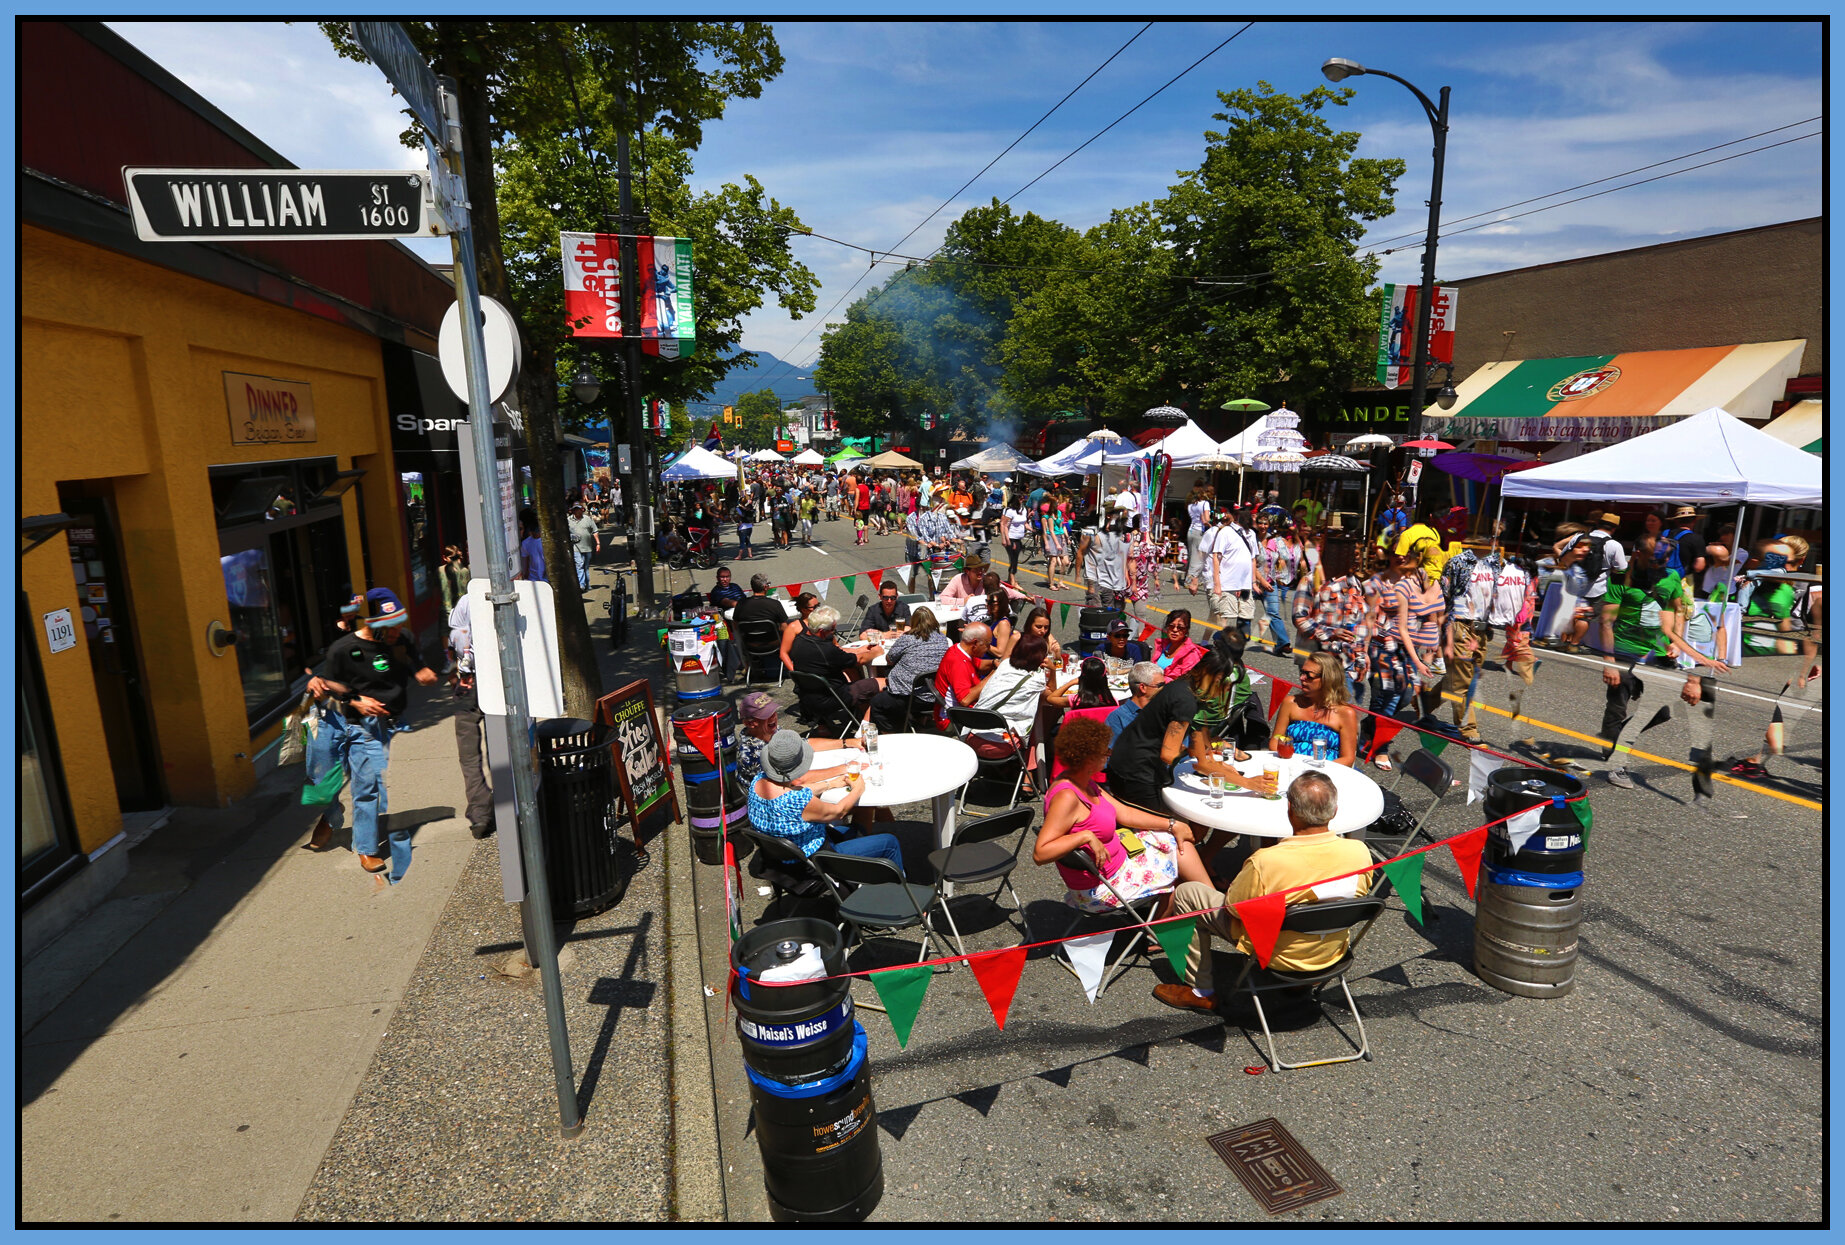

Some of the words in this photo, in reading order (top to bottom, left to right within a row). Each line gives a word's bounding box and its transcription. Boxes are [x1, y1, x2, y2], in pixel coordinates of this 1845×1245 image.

[169, 182, 327, 227] WILLIAM
[370, 183, 390, 205] ST
[360, 205, 409, 227] 1600
[1382, 296, 1393, 334] ITALIAN
[1437, 294, 1450, 331] the
[1379, 333, 1390, 352] DAY
[245, 382, 299, 421] DINNER
[1520, 422, 1536, 436] the
[1539, 422, 1559, 436] best
[1622, 422, 1633, 436] in
[51, 624, 72, 641] 1191
[614, 700, 646, 723] CHOUFFE
[625, 742, 658, 785] Radler
[758, 1025, 795, 1041] Maisel's
[795, 1020, 828, 1041] Weisse
